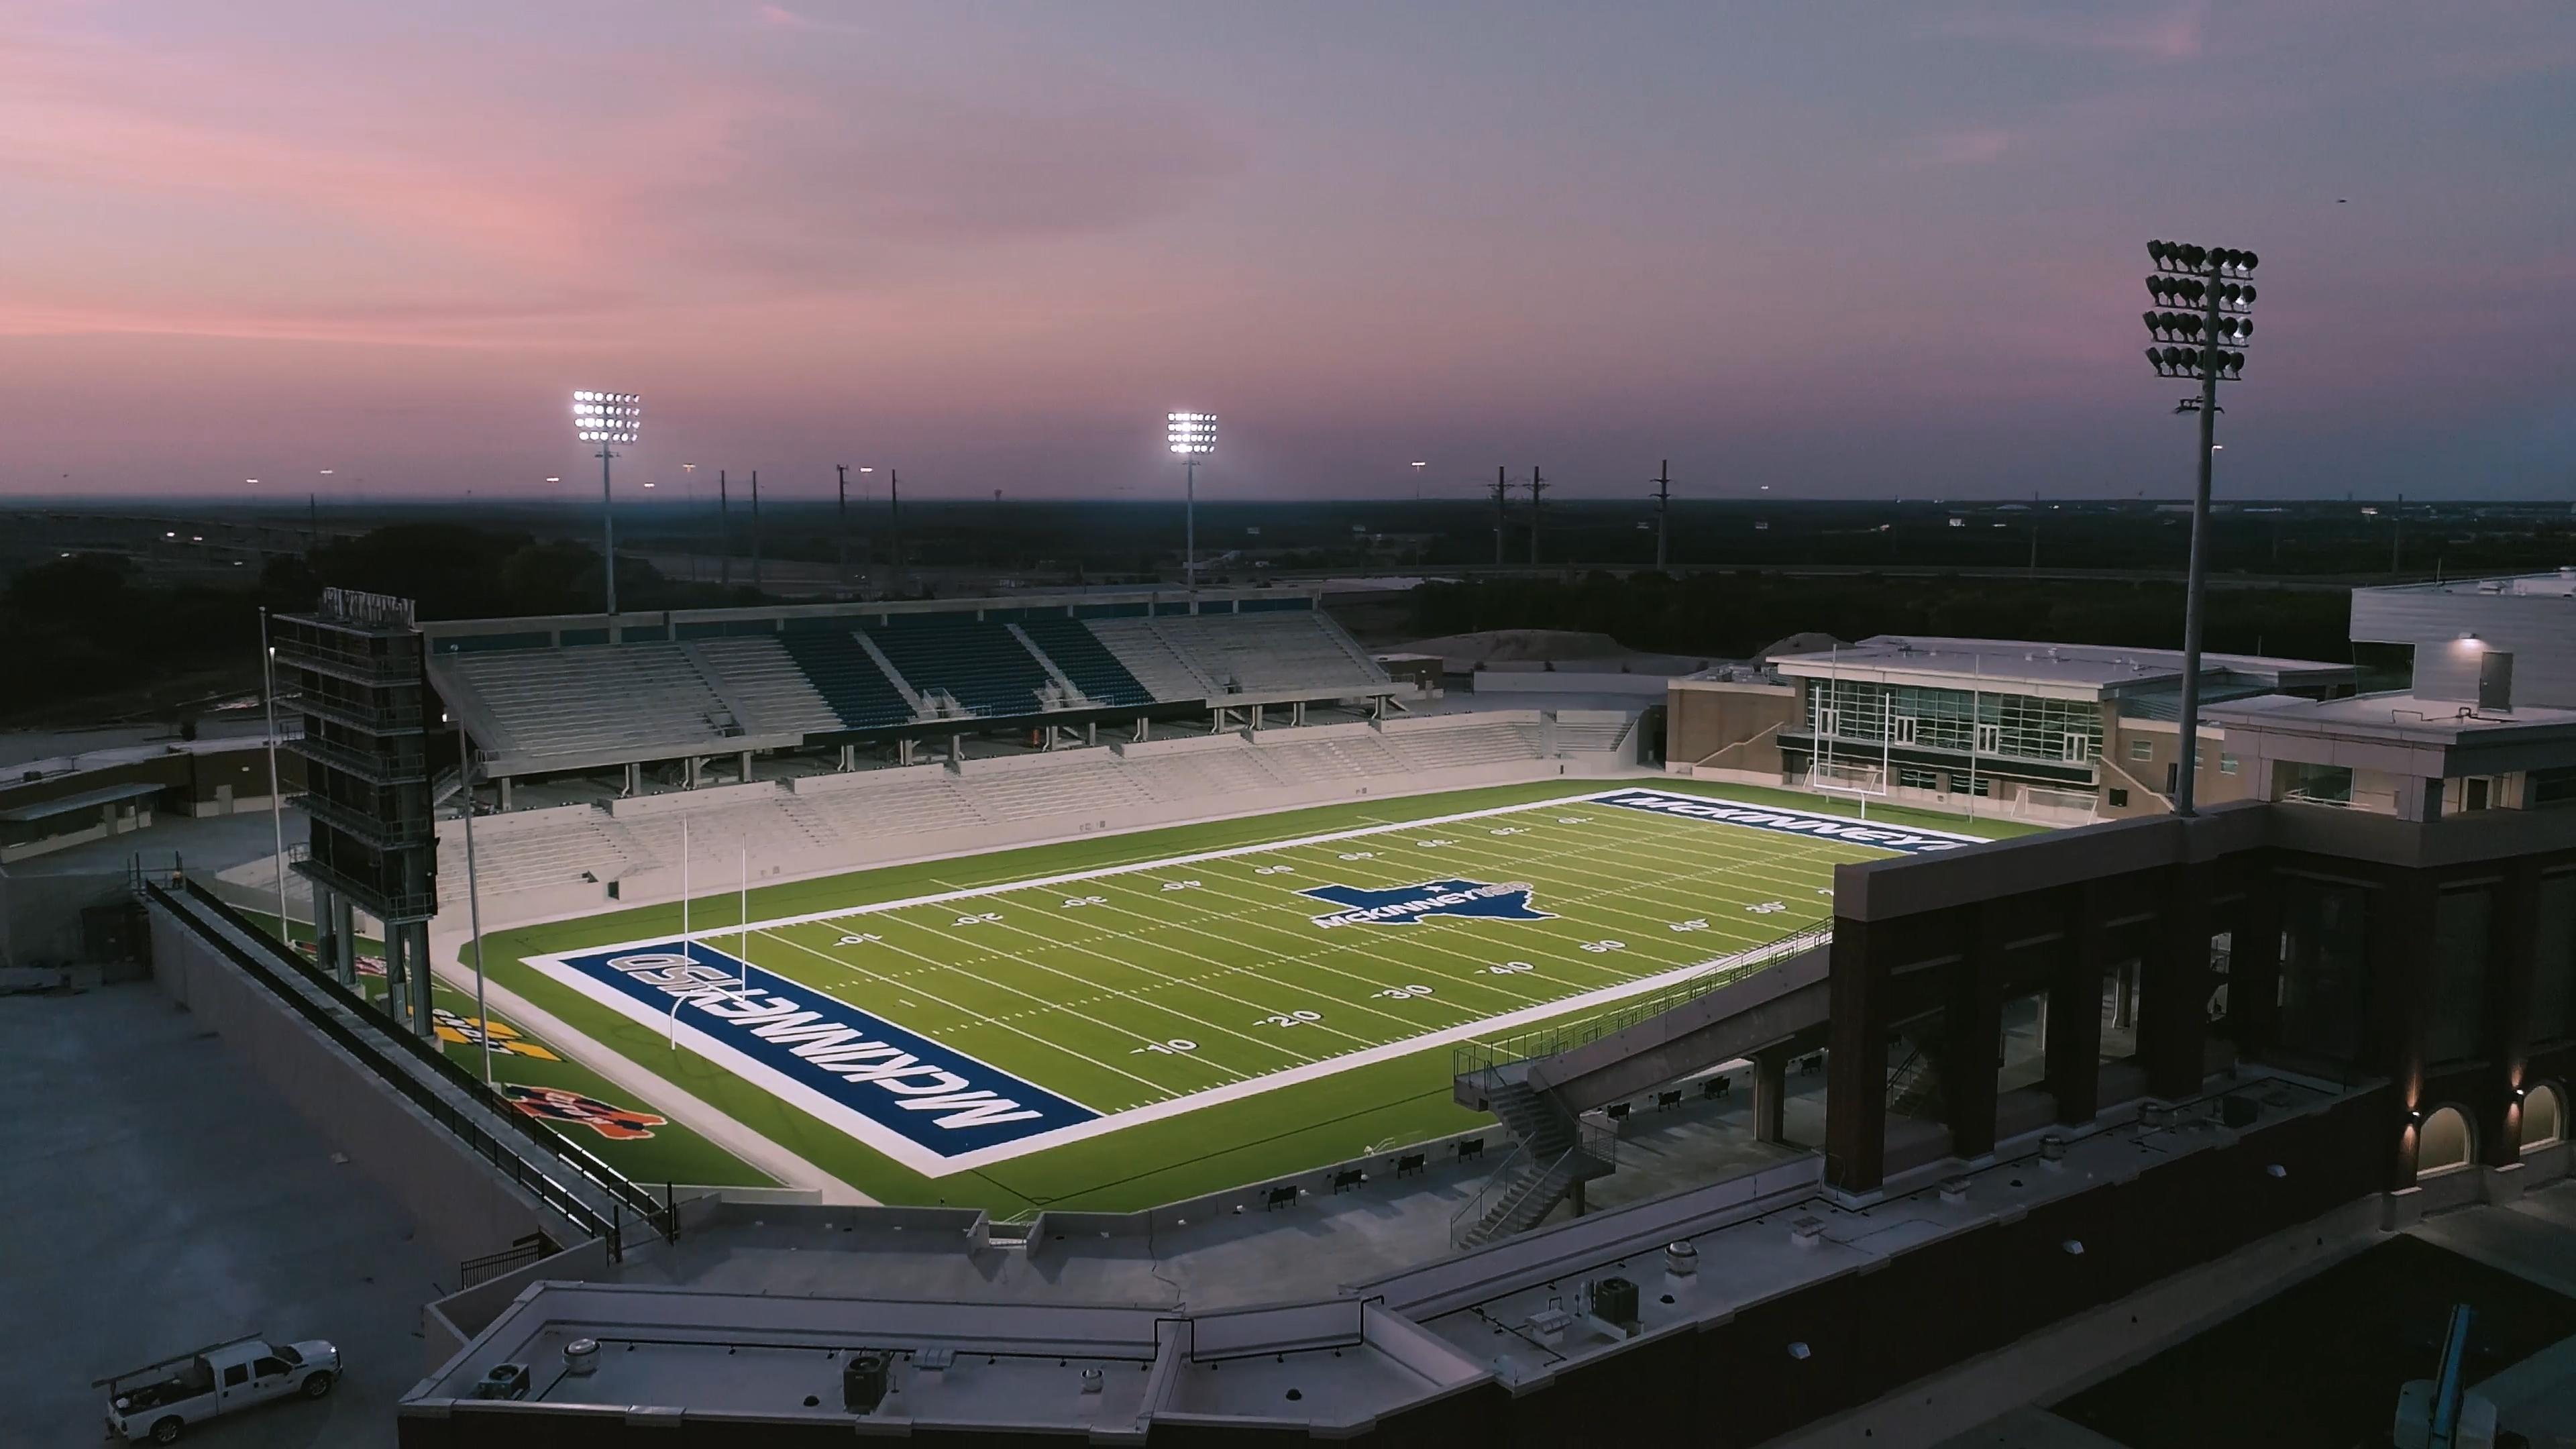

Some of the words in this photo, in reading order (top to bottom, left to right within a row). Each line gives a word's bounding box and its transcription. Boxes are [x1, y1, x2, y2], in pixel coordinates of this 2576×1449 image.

[1163, 880, 1201, 891] 40
[1064, 896, 1108, 908] 30
[1746, 902, 1786, 914] 30
[957, 912, 1004, 926] 20
[1669, 920, 1709, 933] 40
[839, 933, 883, 947] 10
[1579, 939, 1626, 953] 50
[1490, 961, 1535, 975] 40
[1383, 984, 1434, 1000] 30
[1267, 1010, 1322, 1028] 20
[1147, 1038, 1197, 1055] 10
